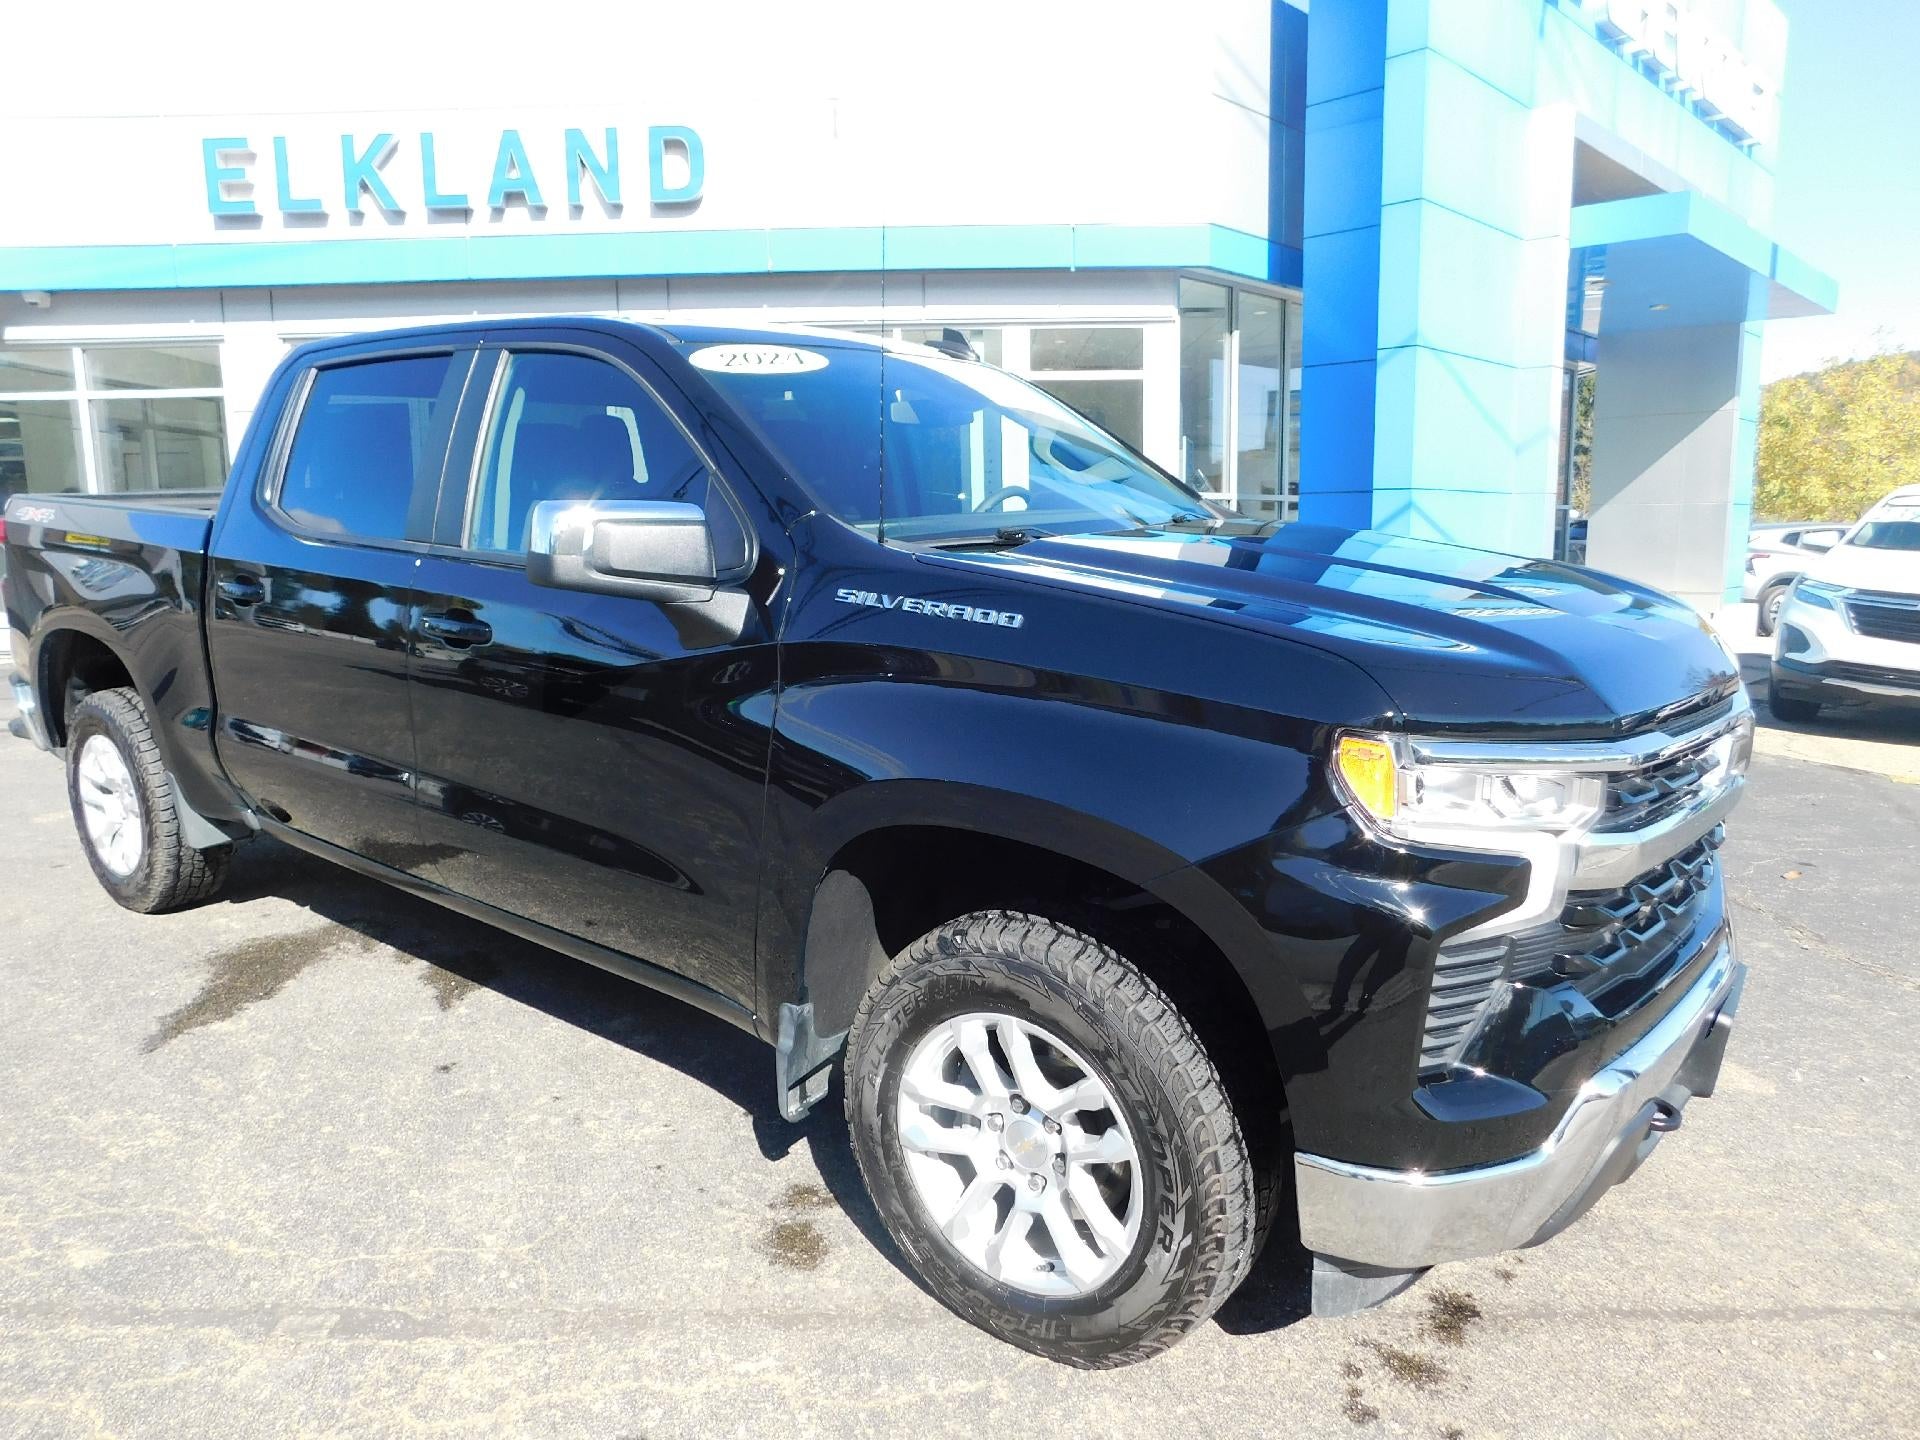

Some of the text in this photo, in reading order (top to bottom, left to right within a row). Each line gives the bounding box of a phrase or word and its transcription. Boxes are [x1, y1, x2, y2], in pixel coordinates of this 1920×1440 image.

[202, 125, 705, 216] ELKLAND
[834, 588, 1025, 629] SILVERADO
[1112, 1065, 1176, 1256] COOPER
